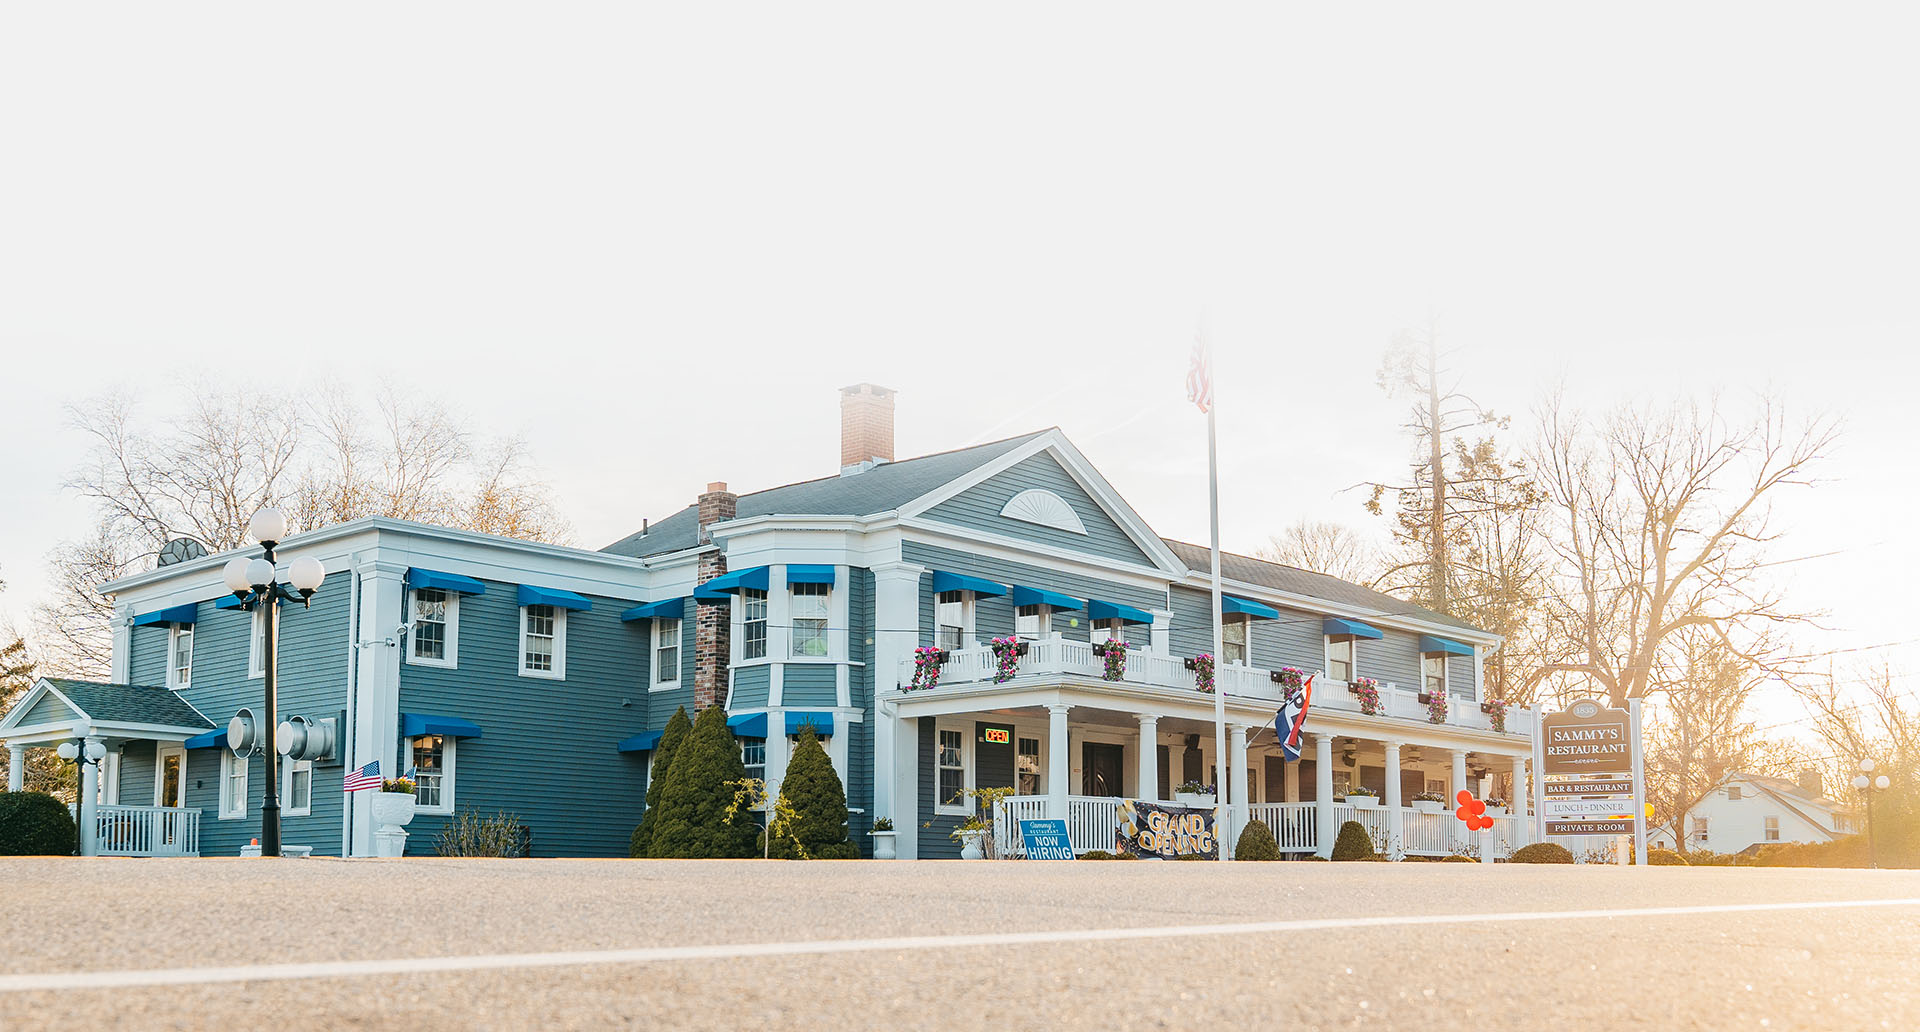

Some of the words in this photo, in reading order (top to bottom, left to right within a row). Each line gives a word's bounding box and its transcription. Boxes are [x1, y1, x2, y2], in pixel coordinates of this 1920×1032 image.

[987, 730, 1008, 742] OPEN
[1554, 729, 1618, 742] SAMMY'S
[1547, 743, 1627, 756] RESTAURANT
[1548, 785, 1564, 793] BAR
[1574, 783, 1630, 792] RESTAURANT
[1554, 804, 1583, 812] LUNCH
[1590, 803, 1624, 811] DINNER
[1147, 810, 1206, 836] GRAND
[1555, 824, 1594, 832] PRIVATE
[1597, 823, 1625, 831] ROOM
[1035, 836, 1059, 847] NOW
[1138, 831, 1212, 856] OPENING
[1028, 846, 1072, 860] HIRING
